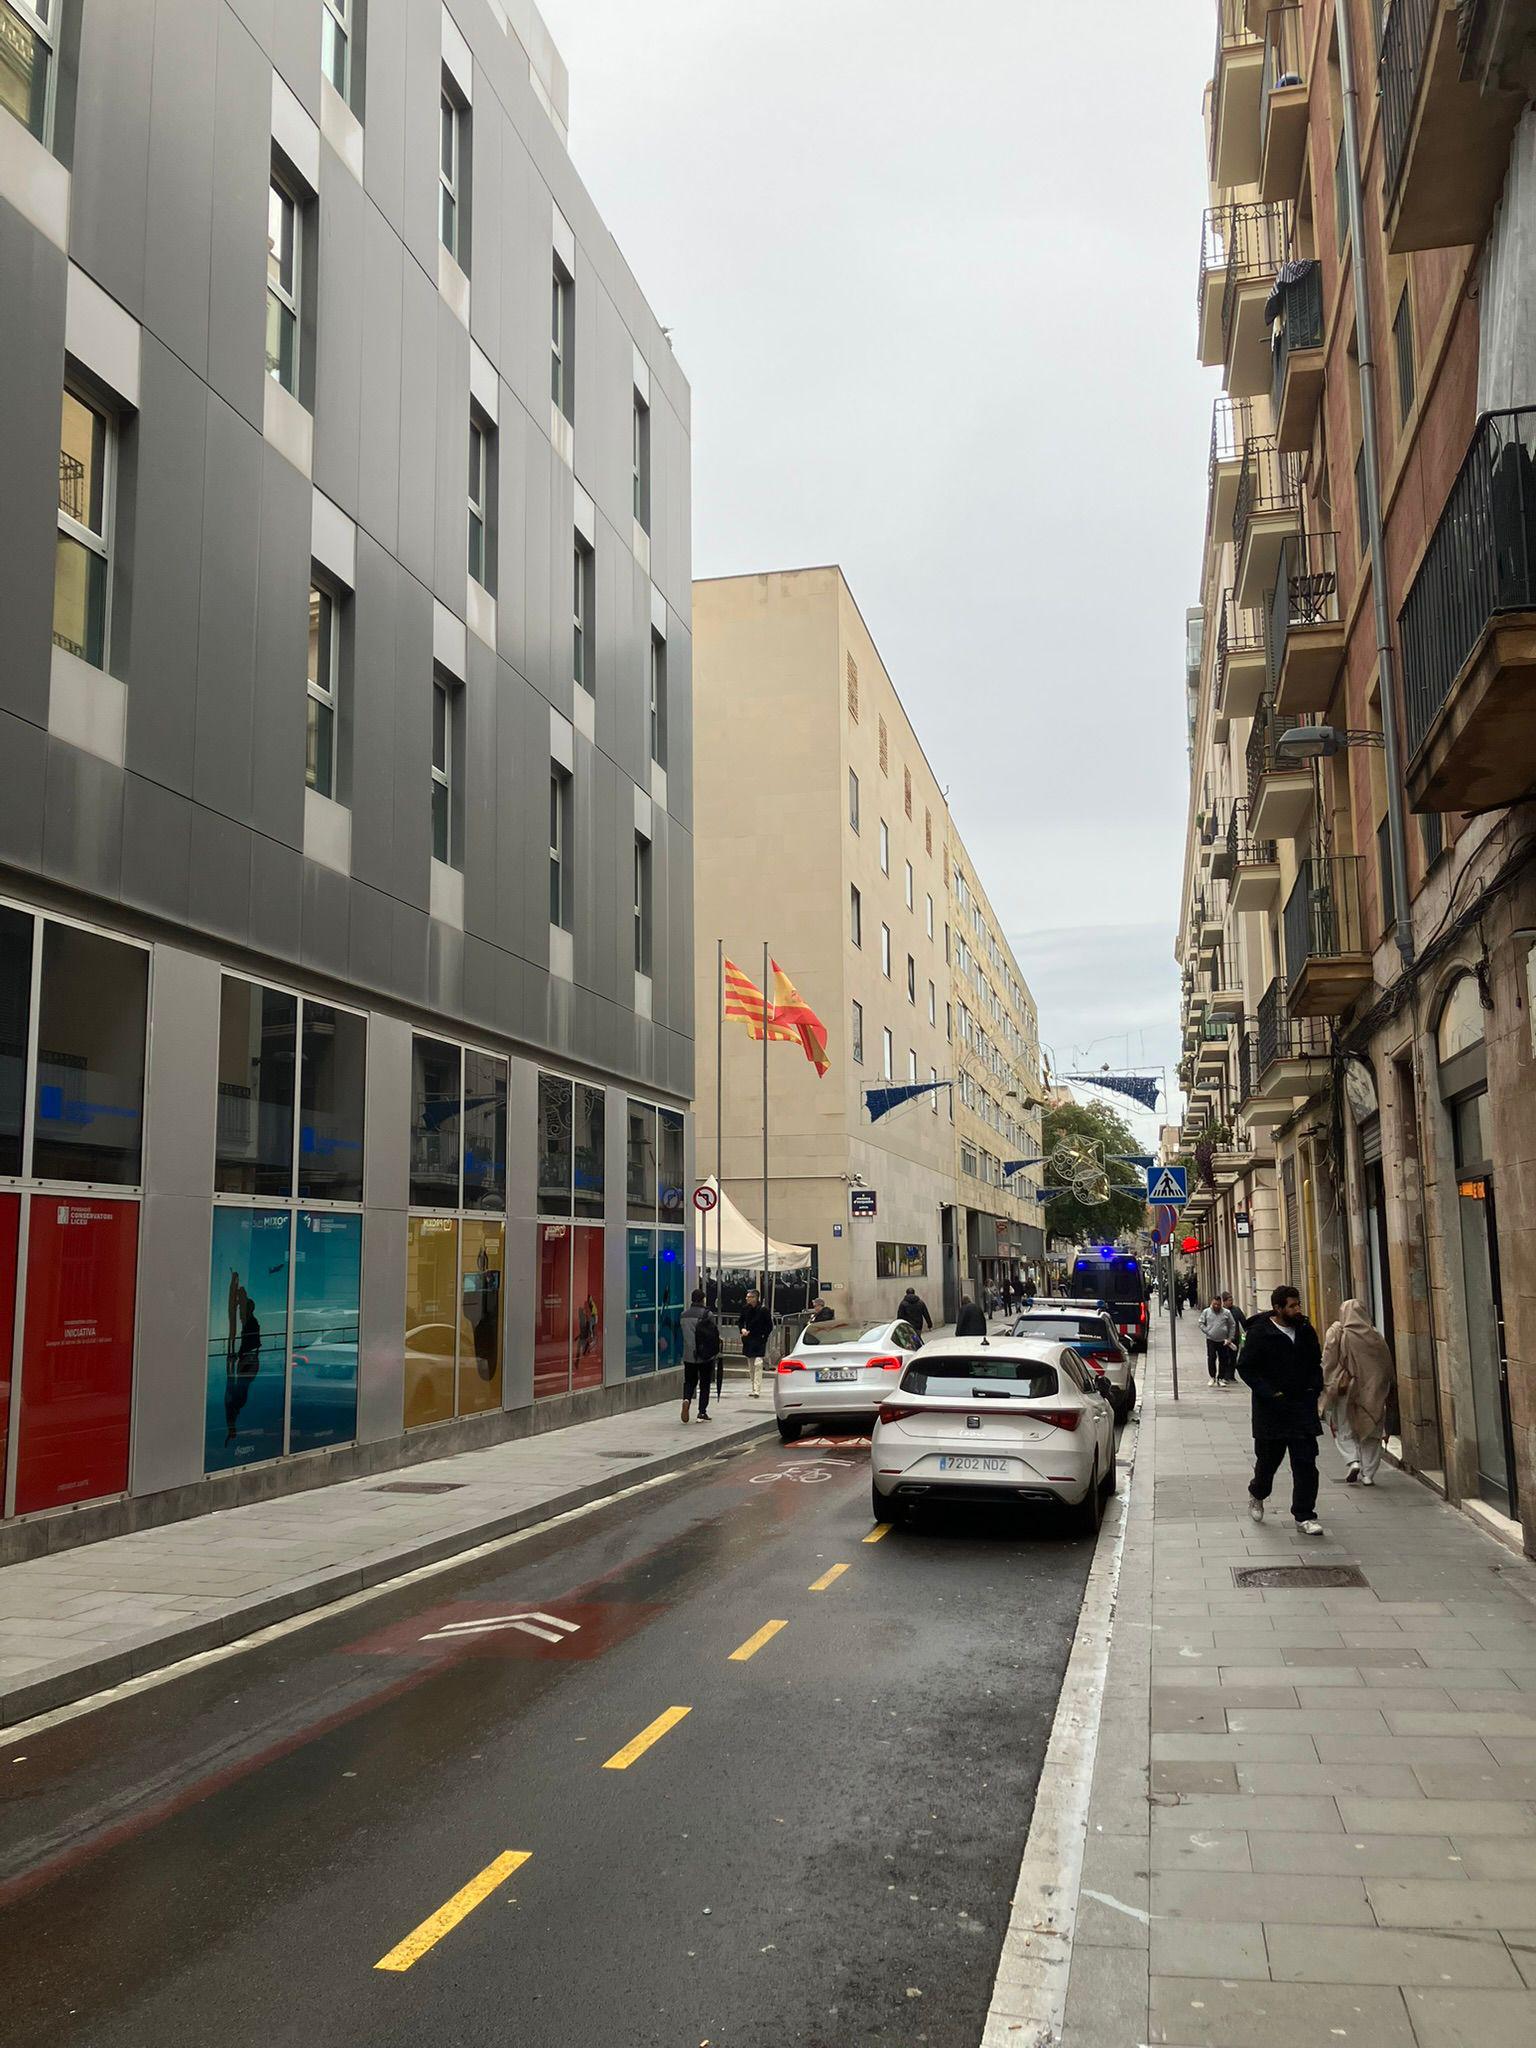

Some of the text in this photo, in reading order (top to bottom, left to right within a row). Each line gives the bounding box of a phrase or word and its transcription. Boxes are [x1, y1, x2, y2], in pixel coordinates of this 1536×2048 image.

[70, 1212, 113, 1220] CONSERVATORI
[64, 1327, 96, 1338] INICIATIVA
[948, 1457, 1007, 1471] 7202 NDZ
